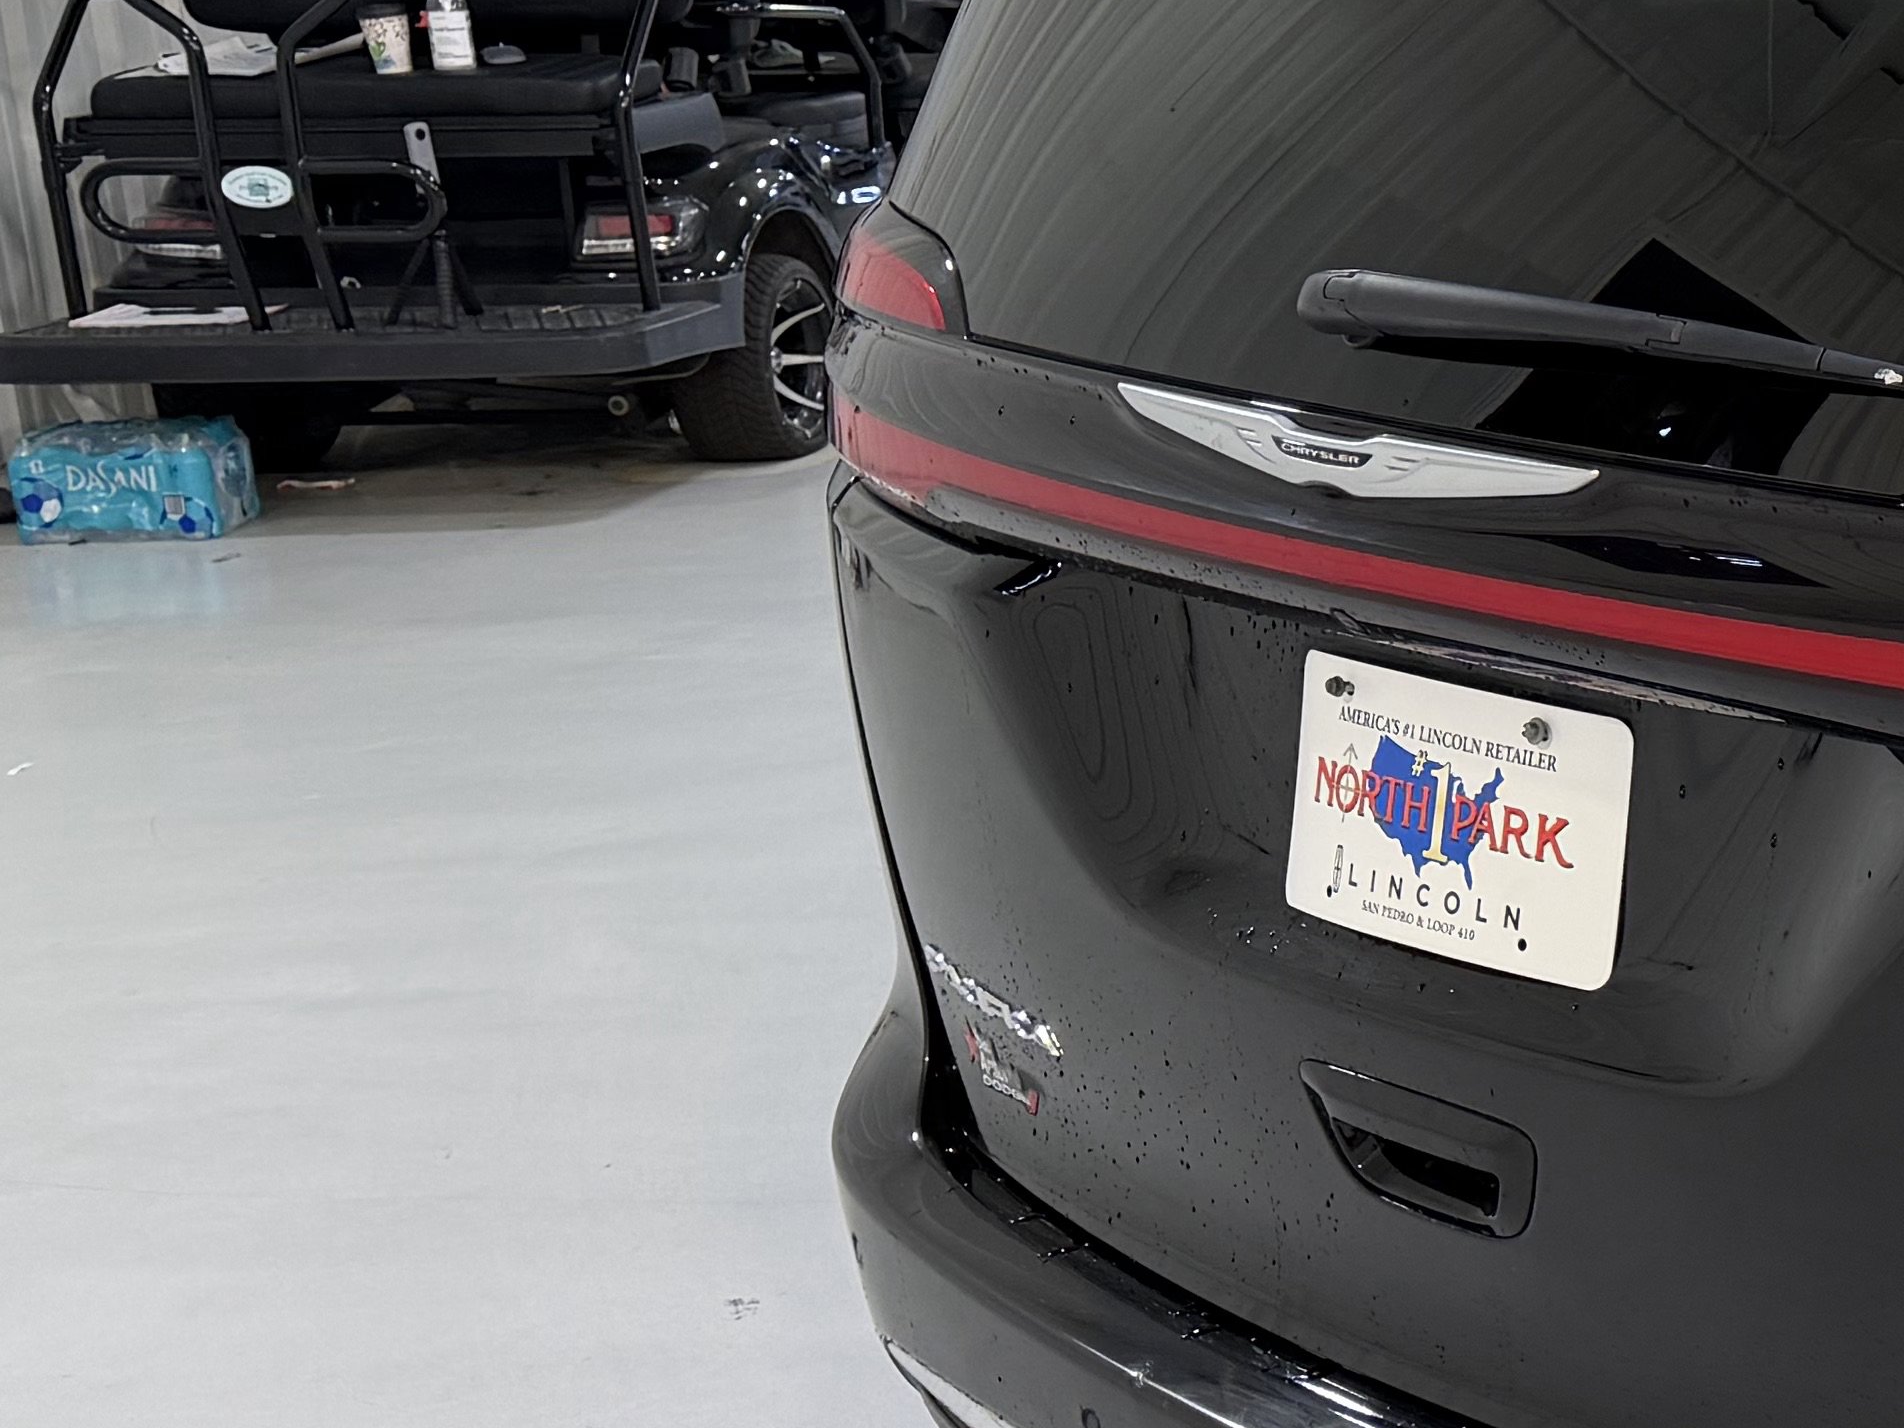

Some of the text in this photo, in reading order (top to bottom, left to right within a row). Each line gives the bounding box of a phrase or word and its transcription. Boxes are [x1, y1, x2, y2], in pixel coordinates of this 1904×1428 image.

[65, 461, 157, 497] DASANI
[1281, 443, 1360, 464] CHRYSLER
[1339, 706, 1401, 736] AMERICA'S
[1419, 726, 1482, 755] LINCOLN
[1485, 743, 1557, 773] RETAILER
[1314, 757, 1574, 870] NORTH PARK
[1348, 863, 1522, 931] LINCOLN
[1361, 900, 1475, 941] SAN PEDRO & LOOP 410
